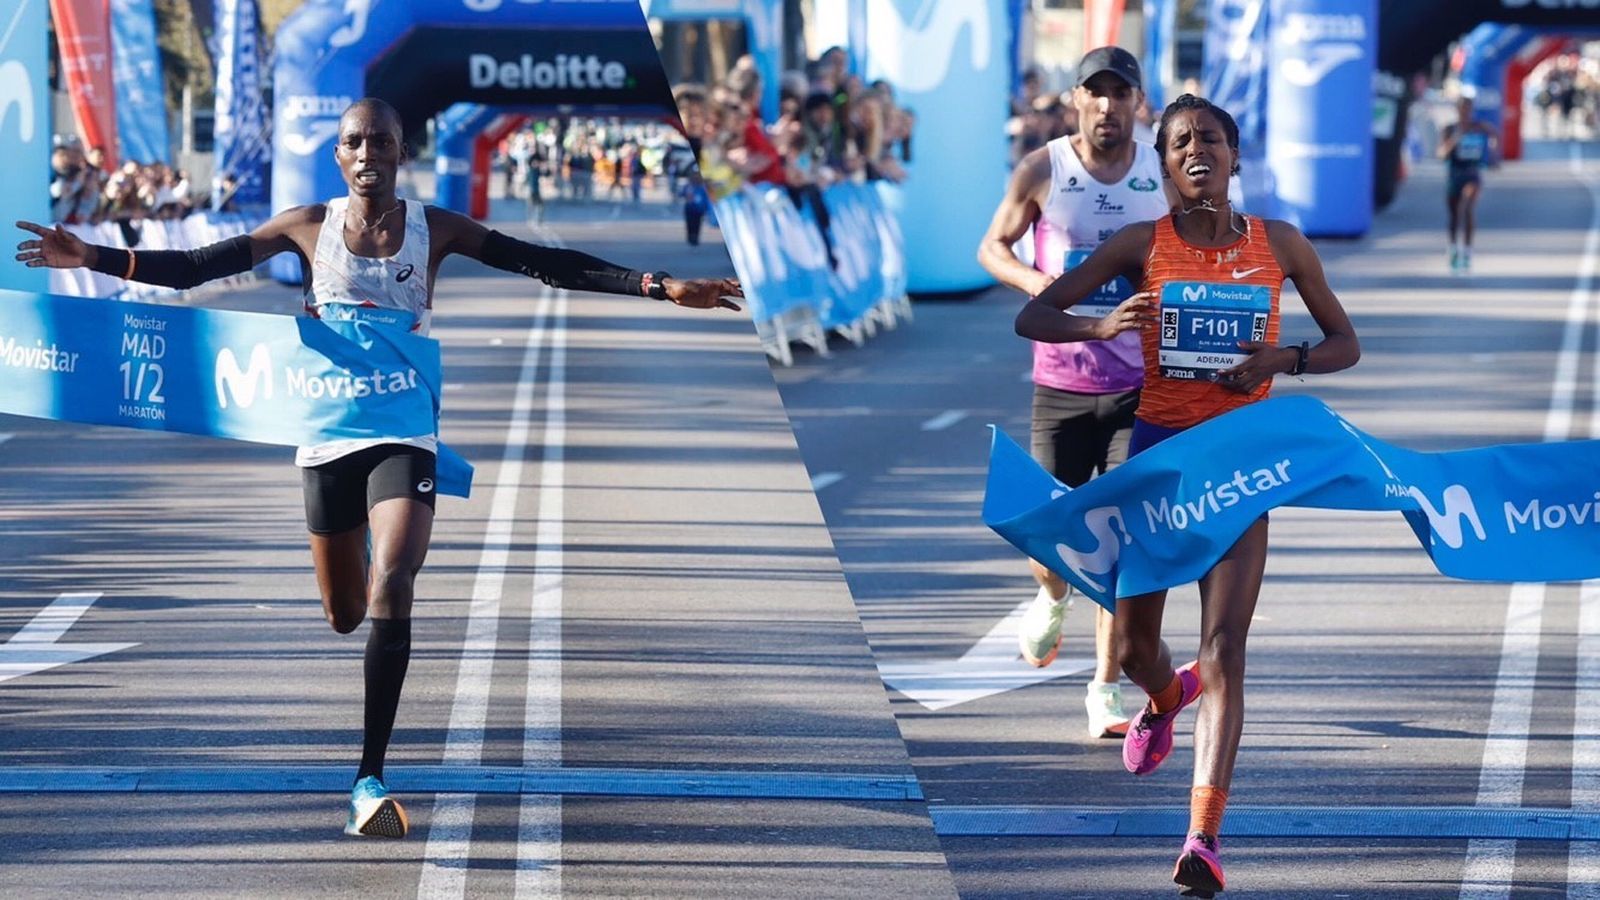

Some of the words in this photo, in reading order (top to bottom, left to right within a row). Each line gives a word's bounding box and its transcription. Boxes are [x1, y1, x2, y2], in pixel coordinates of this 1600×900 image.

[1212, 290, 1252, 301] Movistar
[124, 313, 167, 331] Movistar
[362, 313, 396, 323] Movistar
[1192, 317, 1239, 337] F101
[121, 332, 165, 359] MAD
[1196, 355, 1234, 364] ADERAW
[119, 361, 165, 403] 1/2
[285, 366, 417, 399] Movistar
[119, 404, 165, 420] MARATÓN
[1142, 458, 1293, 534] Movistar
